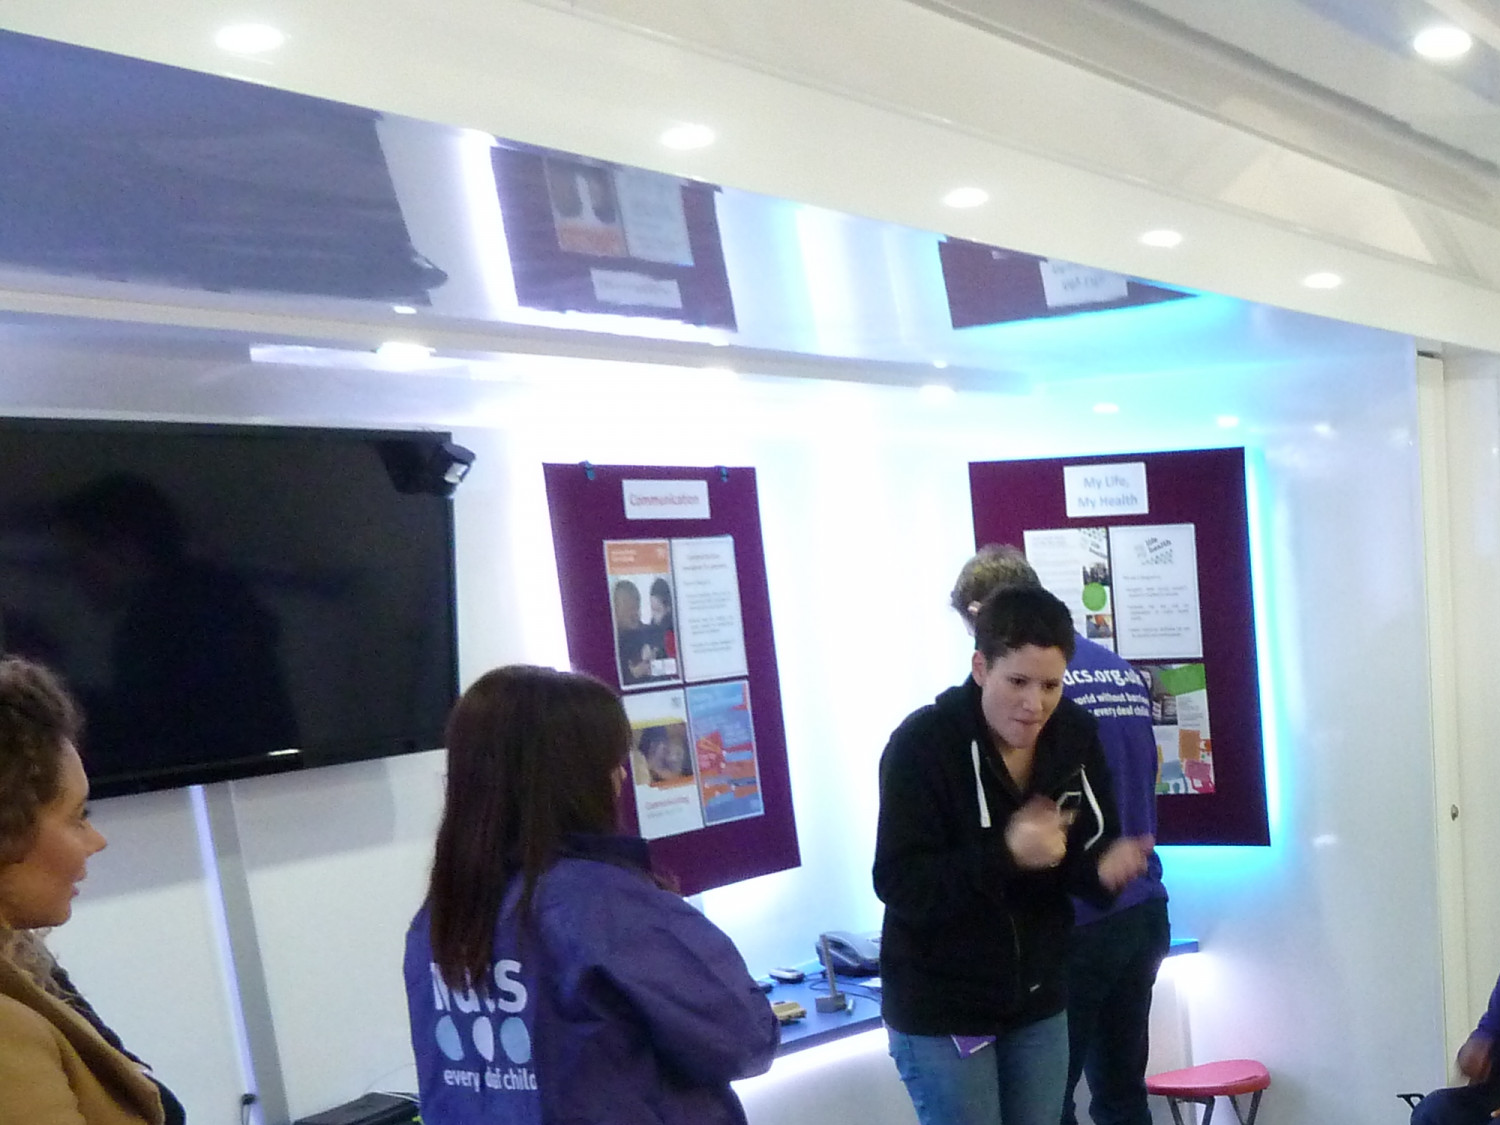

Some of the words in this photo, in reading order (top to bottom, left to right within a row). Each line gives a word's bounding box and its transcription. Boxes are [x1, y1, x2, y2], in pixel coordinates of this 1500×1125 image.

[1084, 477, 1102, 490] My
[1078, 496, 1095, 509] My
[1099, 493, 1138, 507] Health
[443, 1068, 480, 1093] every
